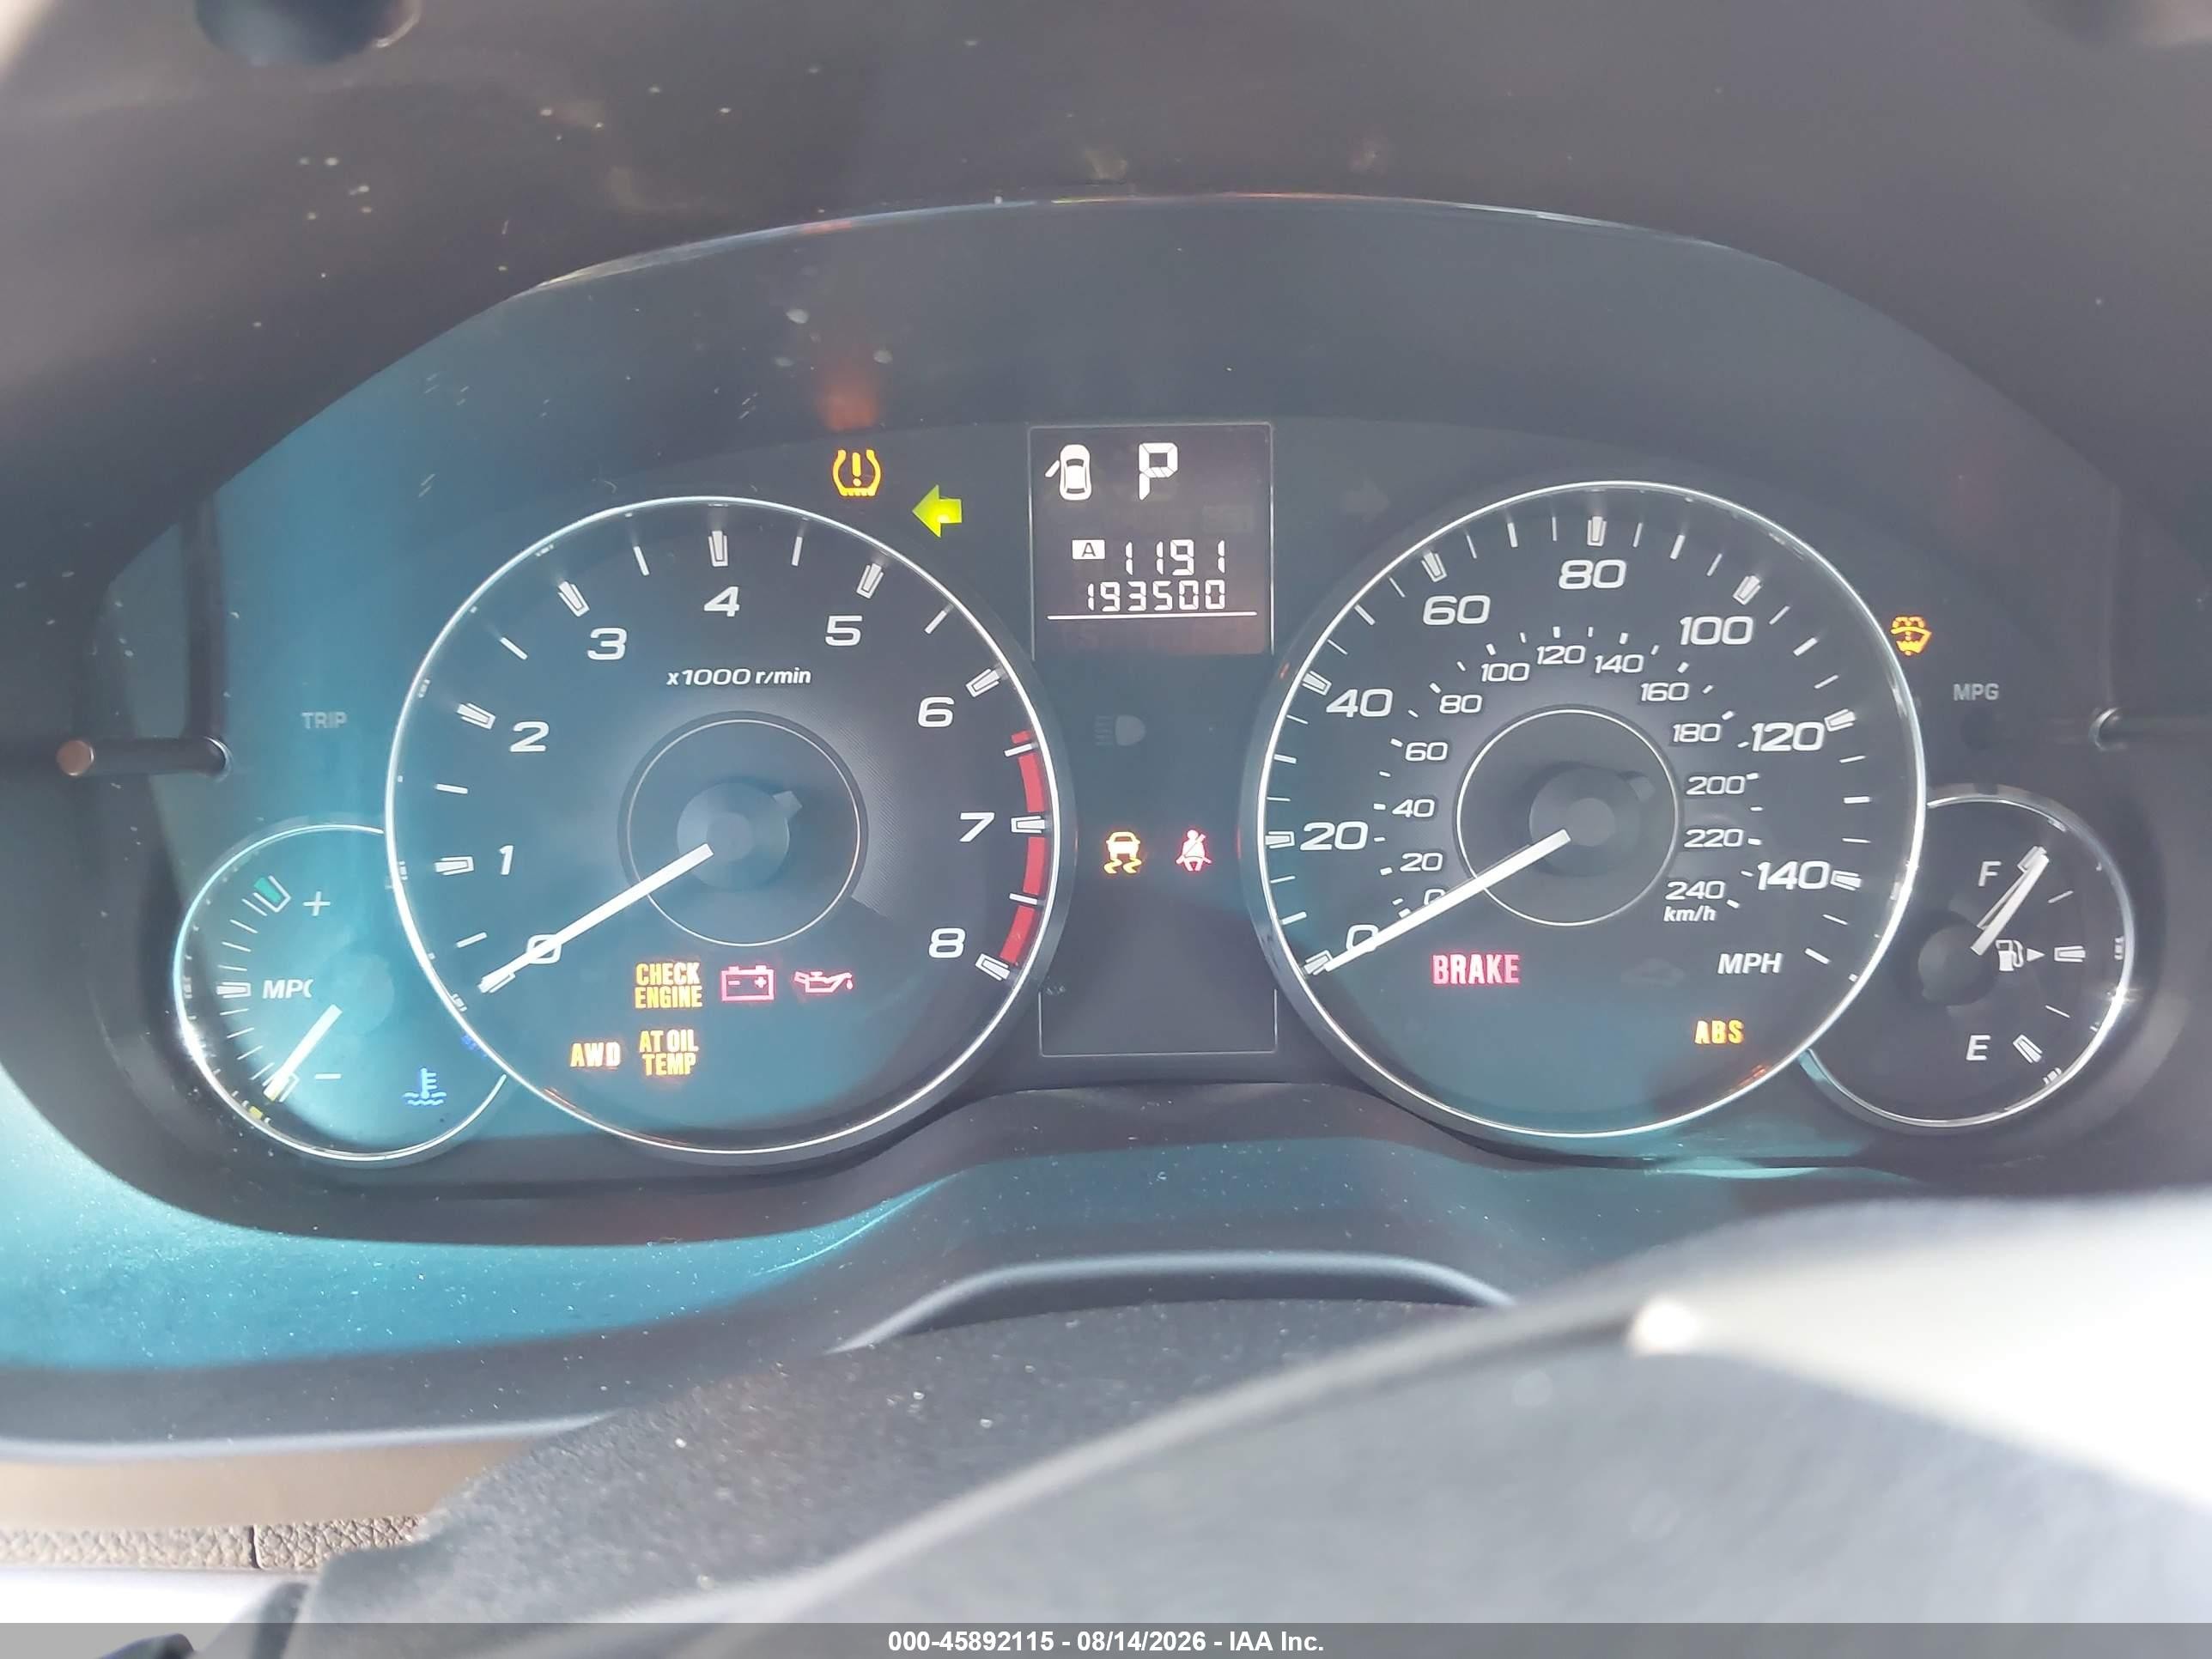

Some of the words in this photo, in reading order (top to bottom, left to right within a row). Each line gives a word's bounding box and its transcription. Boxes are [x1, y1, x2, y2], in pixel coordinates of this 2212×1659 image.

[1139, 442, 1178, 500] P
[1125, 539, 1226, 575] 1191
[1558, 559, 1627, 590] 80
[703, 586, 740, 617] 4
[1088, 579, 1225, 612] 193500
[1422, 594, 1491, 625] 60
[587, 627, 628, 660] 3
[825, 615, 863, 647] 5
[1680, 616, 1753, 646] 100
[1536, 645, 1586, 665] 120
[1595, 653, 1644, 674] 140
[666, 667, 751, 686] x1000
[755, 667, 811, 686] r/min
[1480, 662, 1529, 683] 100
[1326, 689, 1393, 719] 40
[1438, 694, 1483, 714] 80
[1640, 682, 1689, 702] 160
[1953, 684, 1999, 701] MPG
[302, 712, 347, 729] TRIP
[917, 696, 954, 727] 6
[509, 720, 550, 752] 2
[1673, 723, 1721, 743] 180
[1751, 722, 1825, 752] 120
[1405, 742, 1449, 762] 60
[1686, 775, 1745, 796] 200
[1391, 798, 1436, 818] 40
[958, 811, 995, 842] 7
[1300, 822, 1369, 852] 20
[1683, 828, 1744, 848] 220
[499, 845, 514, 875] 1
[1400, 852, 1443, 872] 20
[1756, 860, 1830, 891] 140
[1978, 861, 2002, 886] F
[1667, 879, 1726, 900] 240
[1663, 904, 1717, 923] km/h
[526, 934, 562, 964] 0
[929, 927, 966, 958] 8
[1346, 924, 1379, 952] 0
[635, 963, 700, 986] CHECK
[1431, 953, 1520, 985] BRAKE
[1717, 953, 1783, 975] MPH
[635, 986, 702, 1009] ENGINE
[639, 1030, 664, 1054] AT
[666, 1030, 699, 1054] OIL
[1694, 1020, 1744, 1044] ABS
[570, 1042, 621, 1068] AWD
[1966, 1035, 1991, 1061] E
[642, 1054, 696, 1078] TEMP
